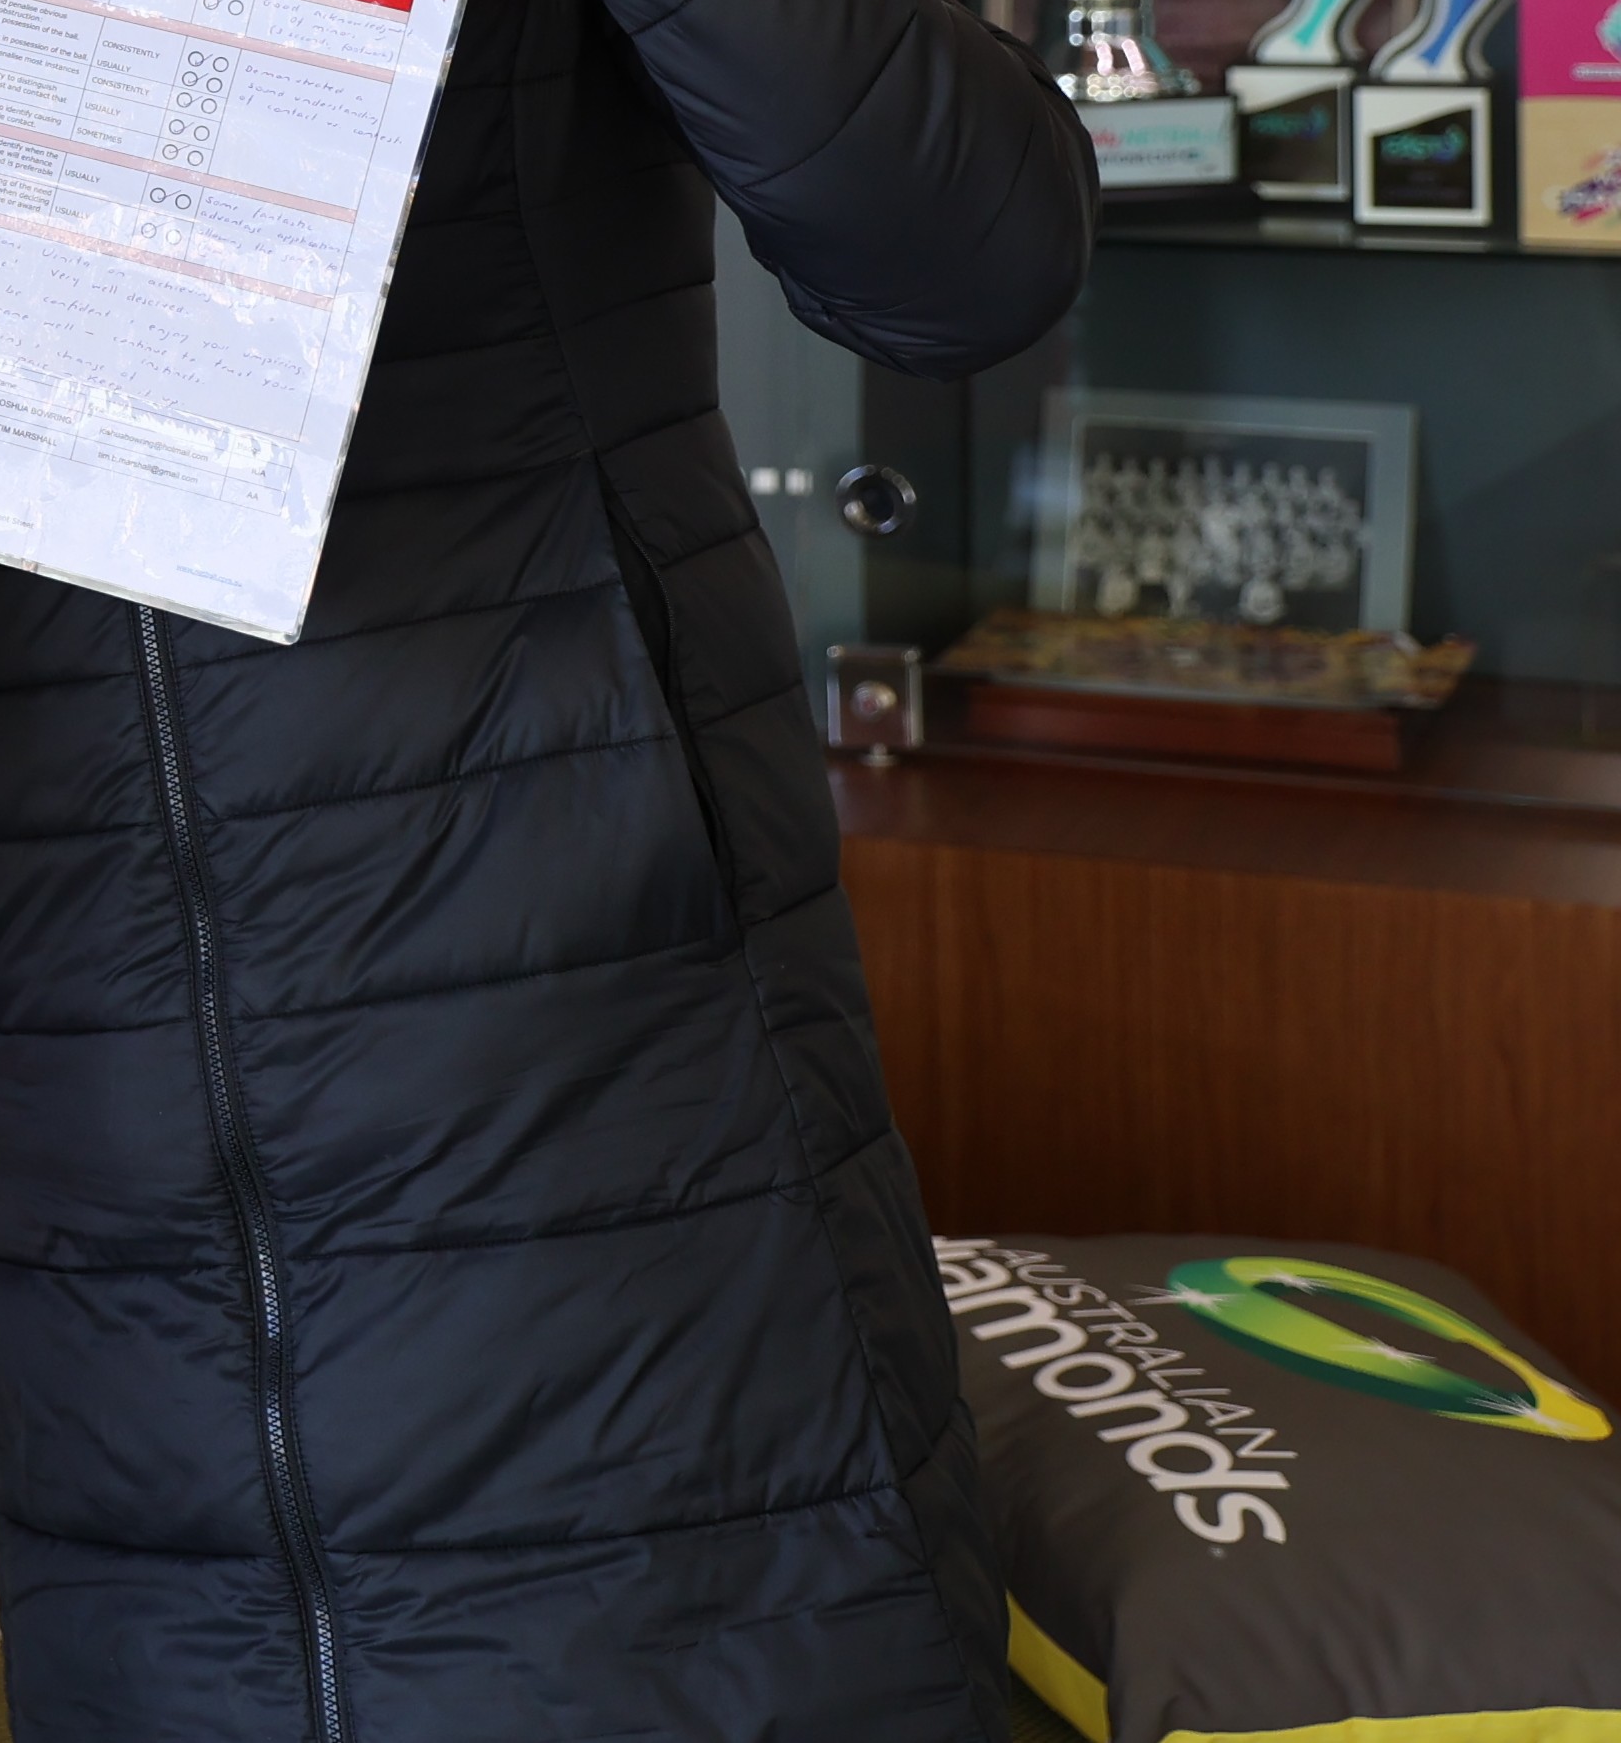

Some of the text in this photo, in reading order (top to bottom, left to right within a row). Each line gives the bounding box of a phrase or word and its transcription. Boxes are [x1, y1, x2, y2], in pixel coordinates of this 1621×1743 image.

[0, 33, 9, 42] in
[8, 36, 50, 52] possession
[49, 45, 60, 54] of
[58, 47, 73, 58] the
[101, 39, 160, 59] CONSISTENTLY
[95, 58, 132, 73] USUALLY
[90, 75, 150, 96] CONSISTENTLY
[83, 100, 122, 116] USUALLY
[75, 126, 123, 145] SOMETIMES
[63, 168, 101, 184] USUALLY
[29, 406, 73, 425] BOWRING
[11, 426, 58, 447] MARSHALL
[982, 1248, 1298, 1460] AUSTRALIAN
